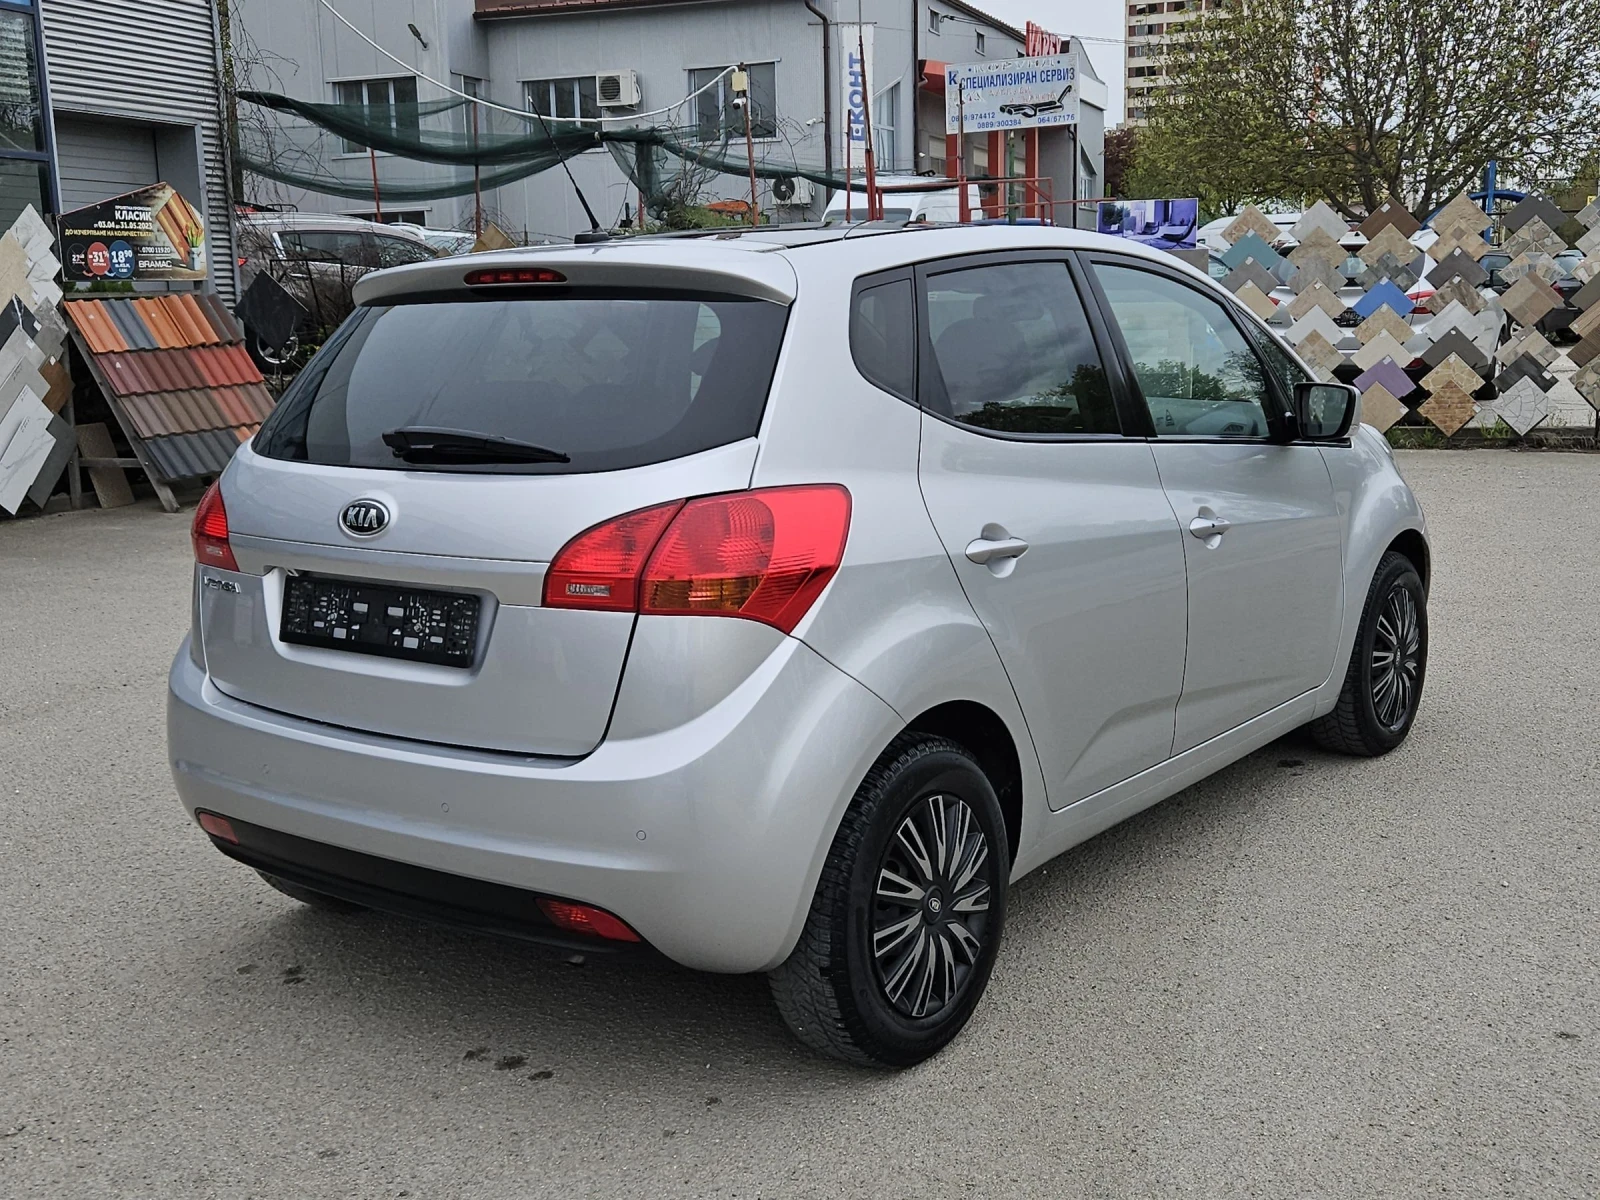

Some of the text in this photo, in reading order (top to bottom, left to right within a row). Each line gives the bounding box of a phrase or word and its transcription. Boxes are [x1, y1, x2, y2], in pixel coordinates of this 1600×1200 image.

[960, 67, 1075, 91] СПЕЦИАЛИЗИРАН СЕРВИЗ
[951, 111, 996, 123] 089/974412
[115, 210, 152, 221] КЛАСИК
[98, 221, 115, 229] 03.04
[120, 221, 153, 230] 31.05.2023
[138, 260, 173, 268] BRAMAC
[346, 506, 378, 528] KIA
